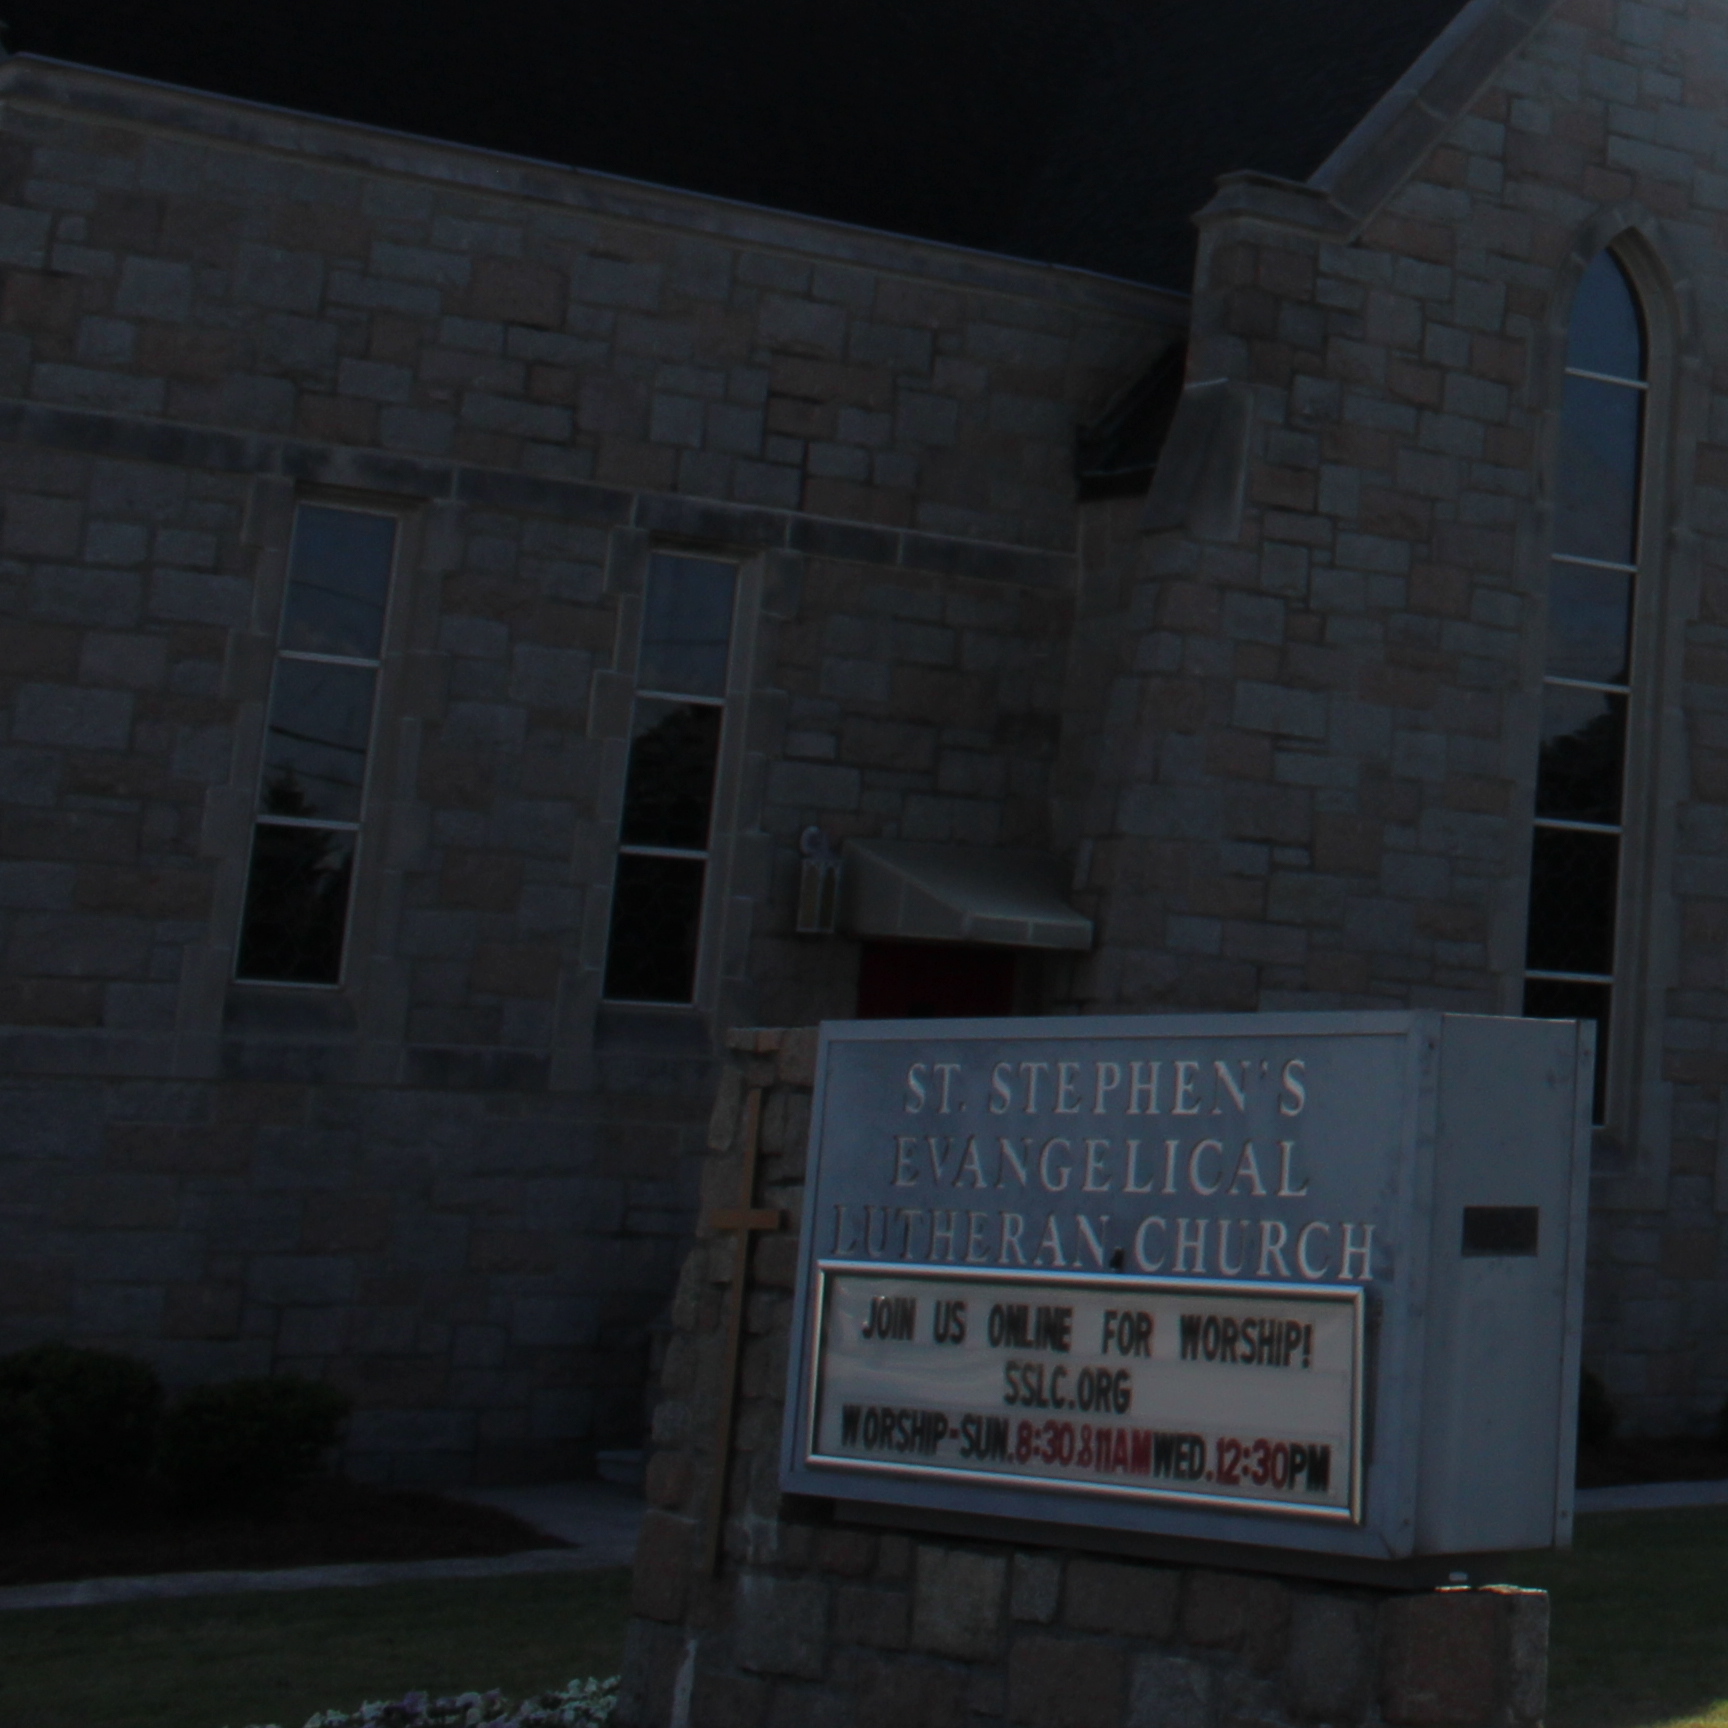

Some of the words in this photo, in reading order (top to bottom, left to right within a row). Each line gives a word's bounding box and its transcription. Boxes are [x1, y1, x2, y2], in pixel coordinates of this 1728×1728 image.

[905, 1062, 966, 1114] ST.
[989, 1059, 1306, 1117] STEPHEN'S
[893, 1134, 1309, 1197] EVANGELICAL
[832, 1203, 1110, 1267] LUTHERAN
[1134, 1215, 1376, 1280] CHURCH
[862, 1297, 917, 1340] JOIN
[934, 1300, 967, 1344] US
[988, 1304, 1074, 1352] ONLINE
[1102, 1309, 1154, 1357] FOR
[1179, 1314, 1313, 1368] WORSHIP!
[1003, 1360, 1132, 1414] SSLC.ORG
